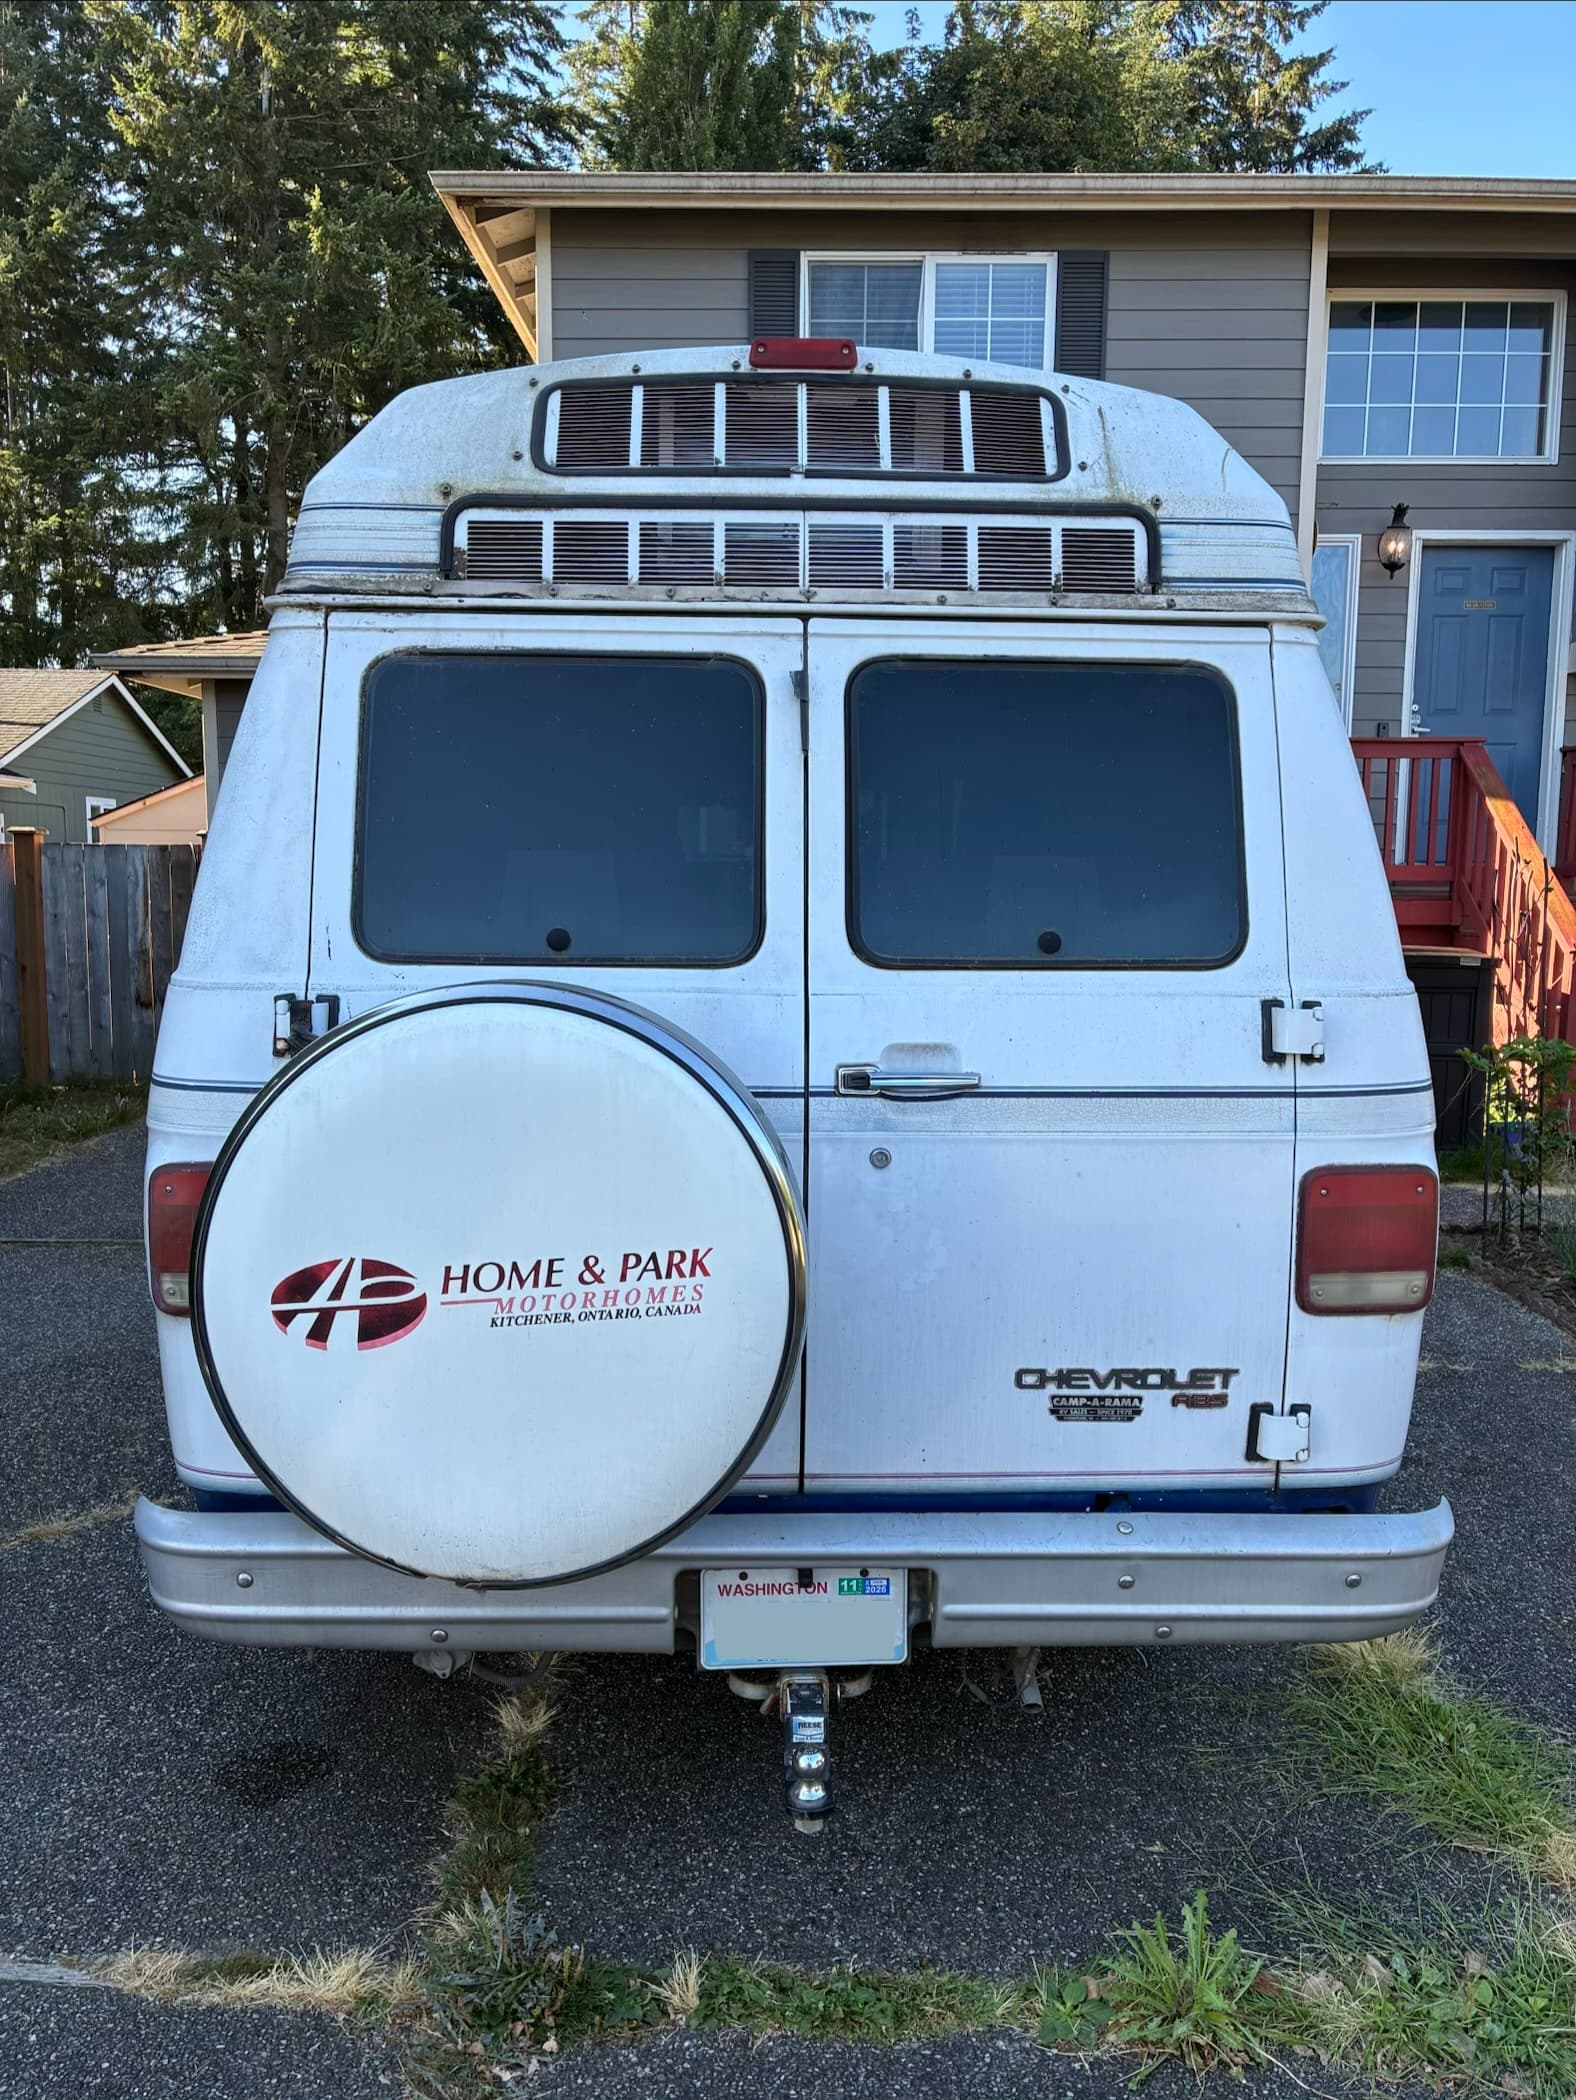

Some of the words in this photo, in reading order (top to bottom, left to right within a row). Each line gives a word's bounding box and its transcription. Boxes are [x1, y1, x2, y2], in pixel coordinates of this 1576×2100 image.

[441, 1257, 565, 1295] HOME
[577, 1254, 606, 1286] &
[619, 1247, 714, 1283] PARK
[494, 1283, 704, 1315] MOTORHOMES
[489, 1311, 576, 1328] KITCHENER,
[577, 1307, 642, 1322] ONTARIO,
[645, 1304, 702, 1318] CANADA
[1014, 1368, 1240, 1390] CHEVROLET
[1053, 1397, 1140, 1407] CAMP-A-RAMA
[1171, 1393, 1229, 1408] ABS
[717, 1581, 829, 1598] WASHINGTON
[840, 1579, 857, 1592] 11
